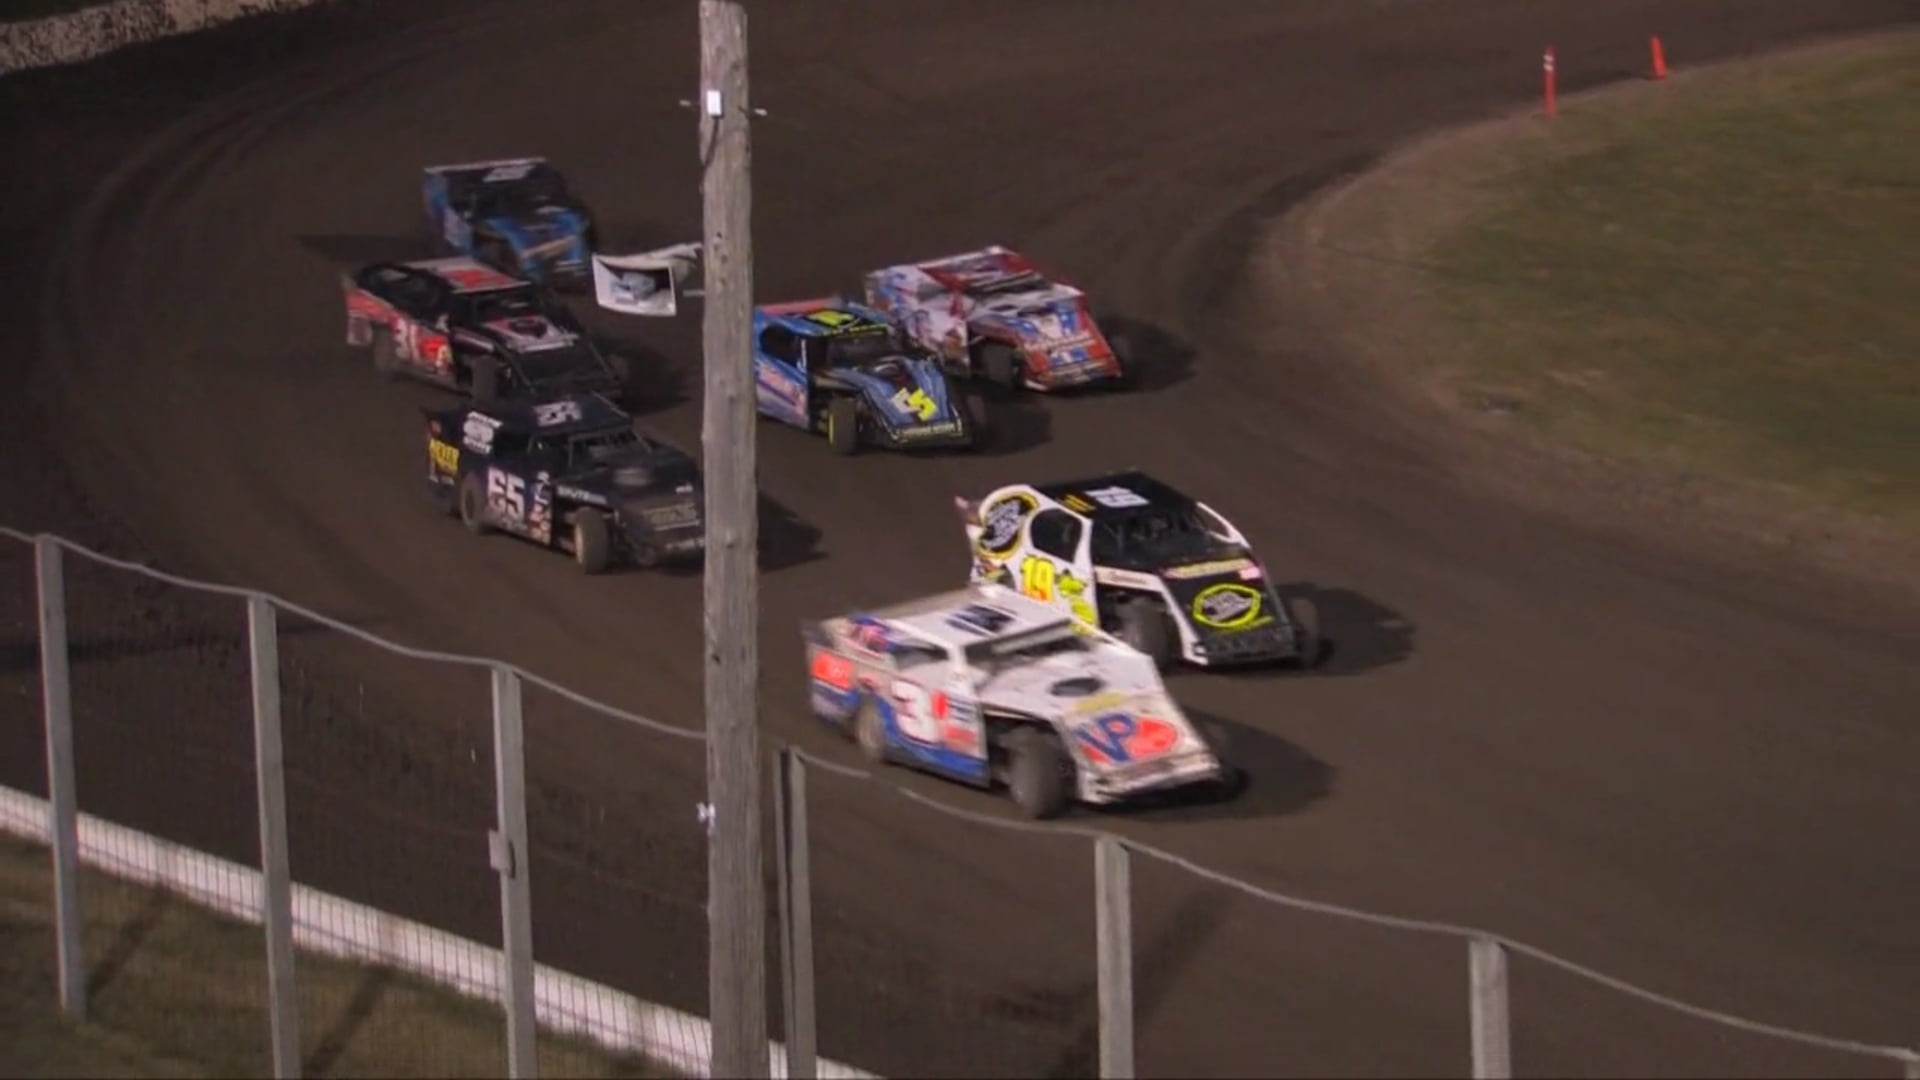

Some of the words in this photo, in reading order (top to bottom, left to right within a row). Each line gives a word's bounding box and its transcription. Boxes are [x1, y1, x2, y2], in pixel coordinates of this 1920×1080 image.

[486, 466, 527, 524] 65
[1021, 555, 1056, 602] 19
[1074, 713, 1137, 762] VP
